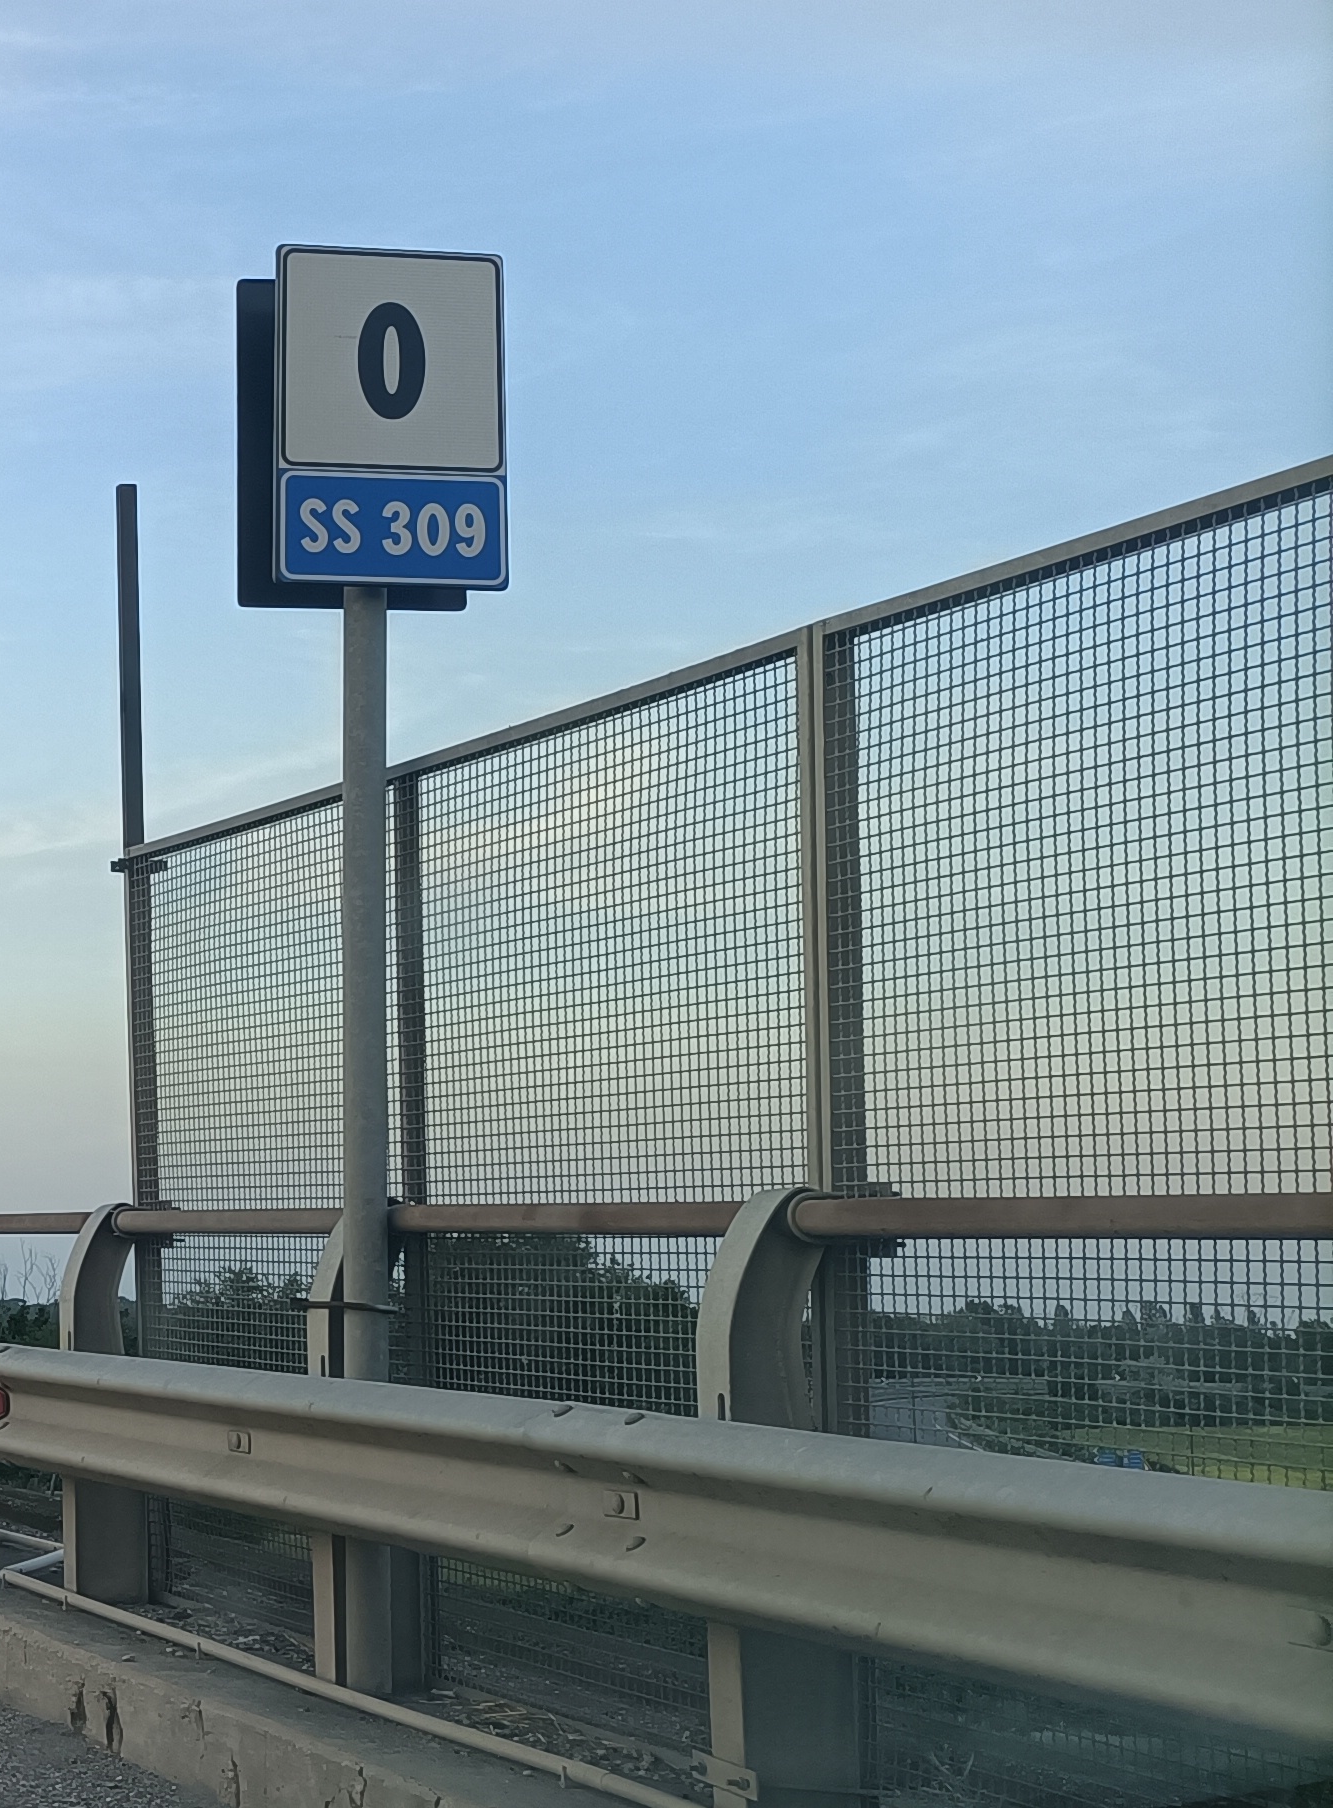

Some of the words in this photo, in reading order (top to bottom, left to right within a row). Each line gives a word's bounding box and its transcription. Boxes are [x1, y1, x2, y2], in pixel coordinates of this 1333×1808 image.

[358, 302, 425, 419] 0
[299, 497, 361, 554] SS
[382, 501, 486, 557] 309
